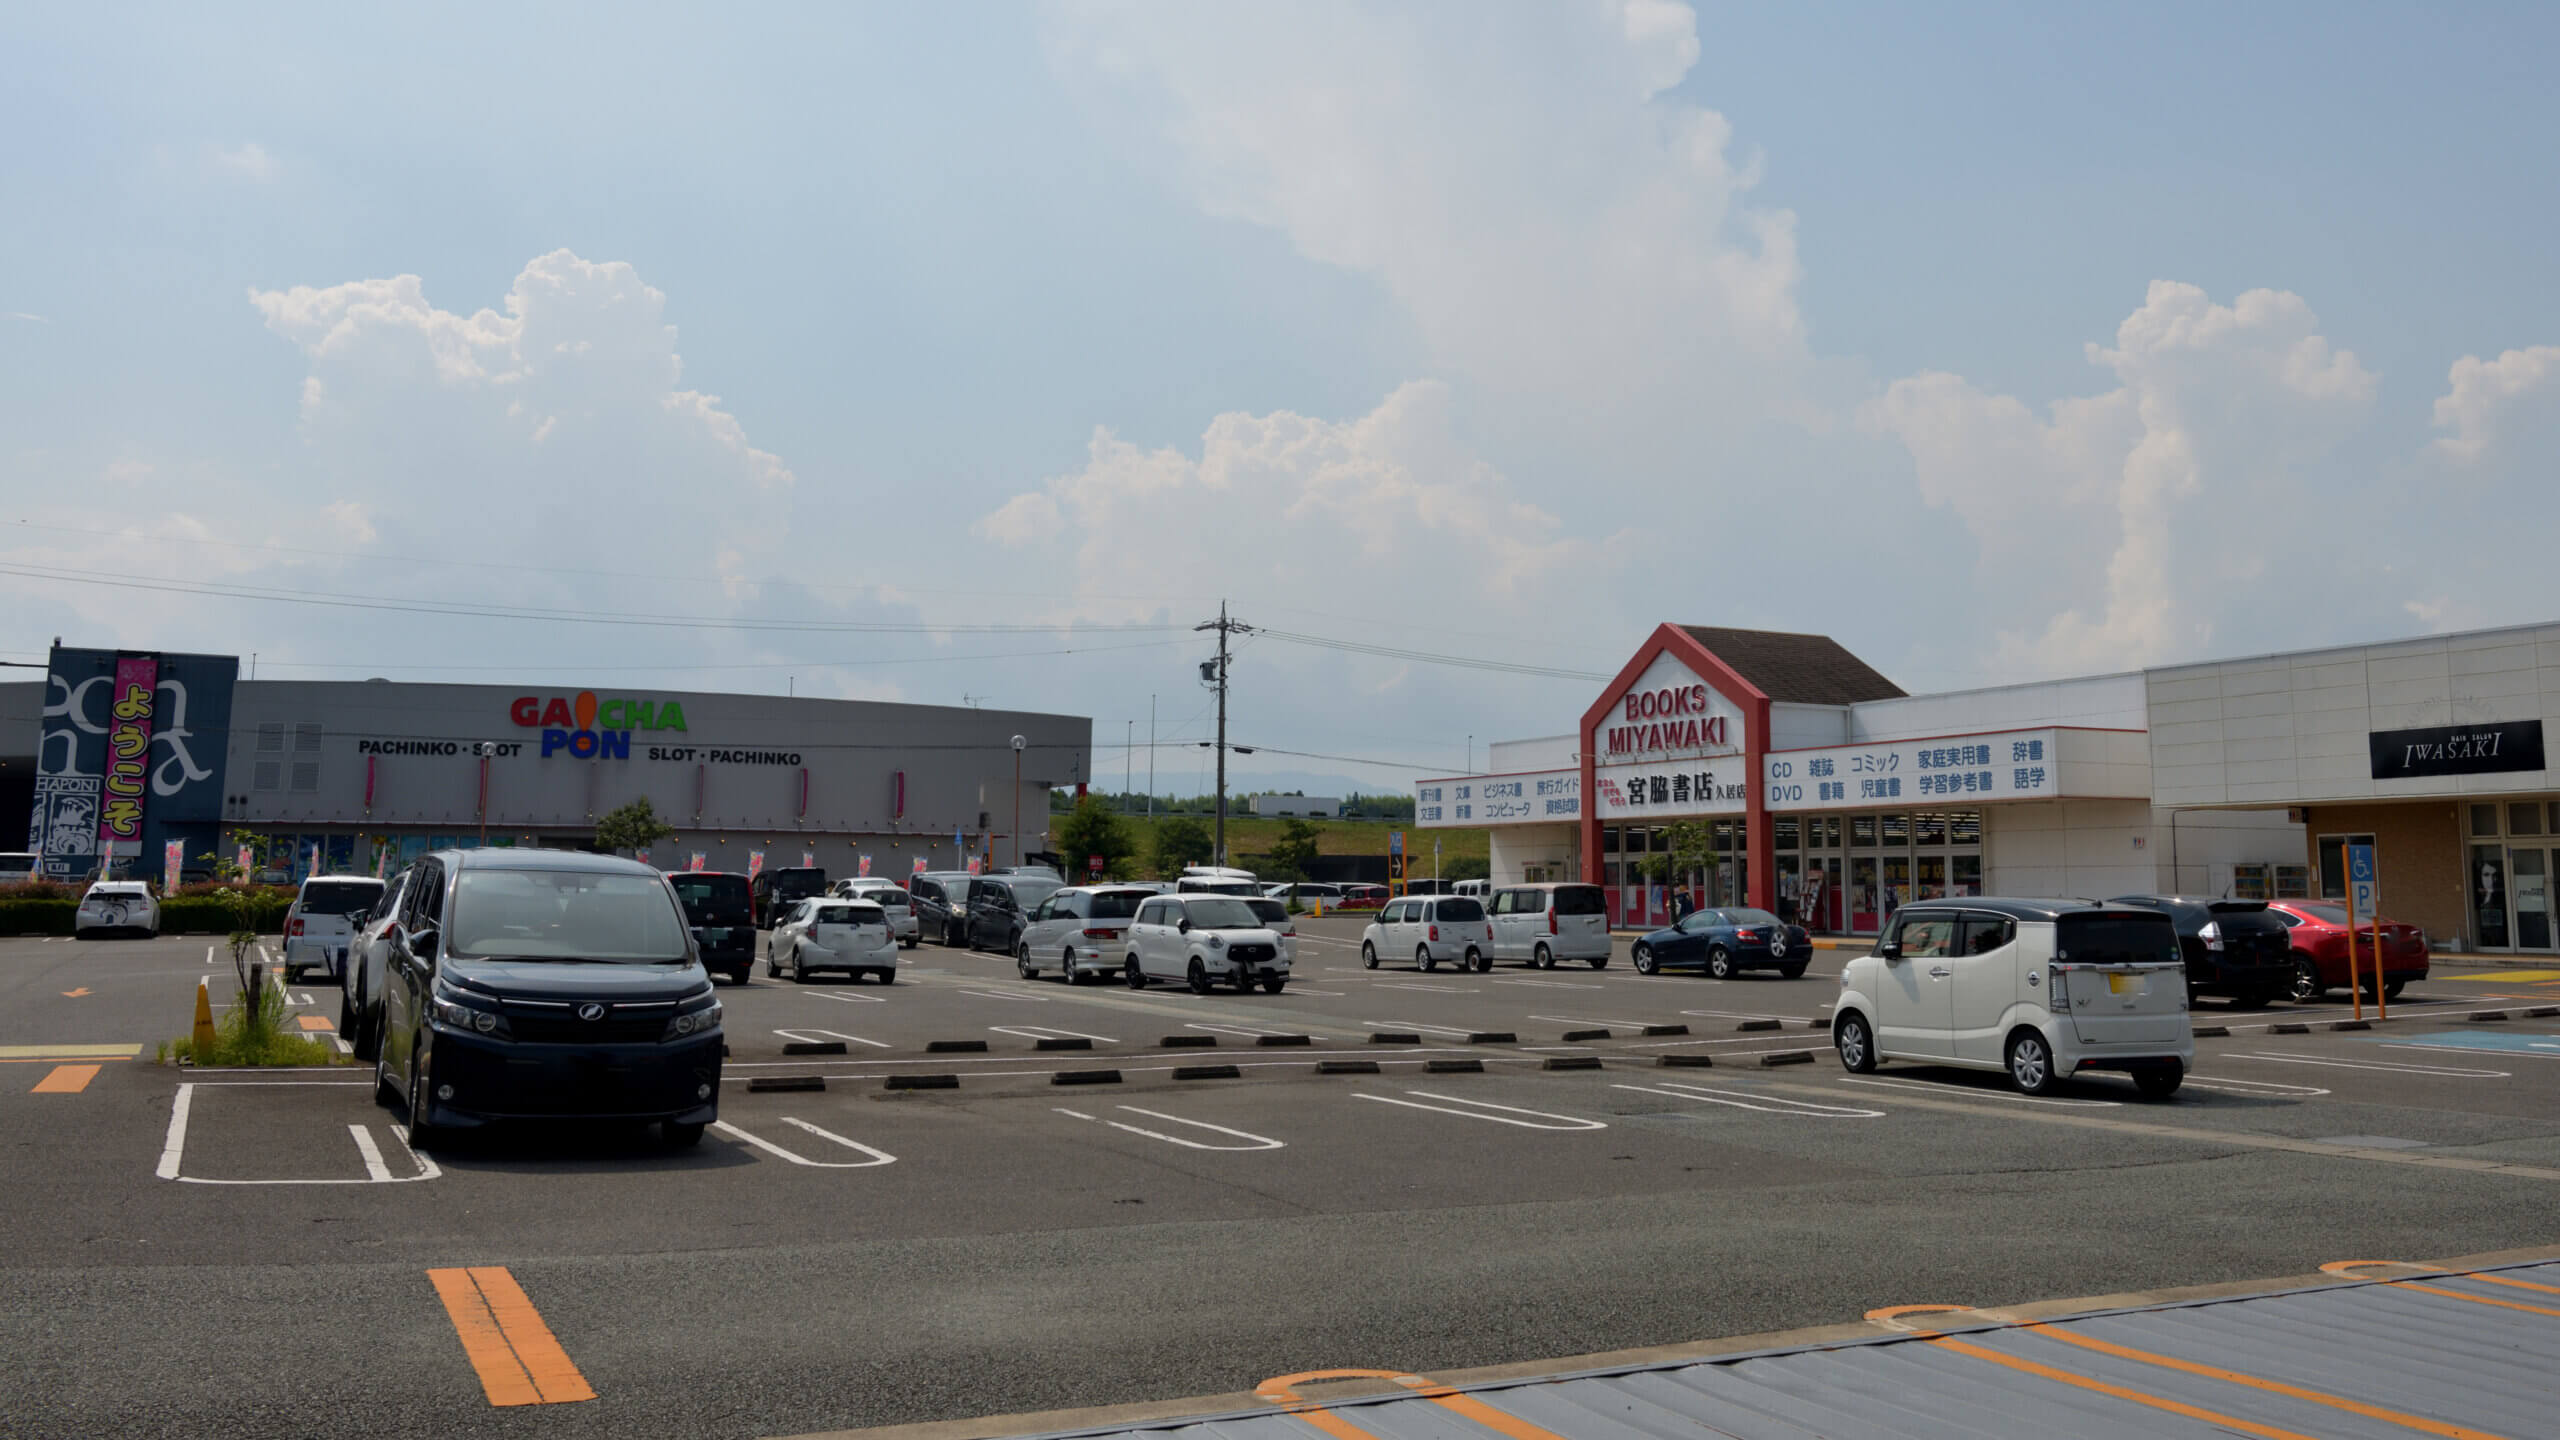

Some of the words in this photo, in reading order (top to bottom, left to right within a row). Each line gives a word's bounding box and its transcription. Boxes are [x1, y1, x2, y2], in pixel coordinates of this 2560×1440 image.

[1626, 684, 1706, 721] BOOKS
[359, 740, 458, 756] PACHINKO
[472, 743, 522, 757] SOT
[541, 729, 630, 759] PON
[1609, 716, 1725, 754] MIYAWAKI
[2402, 732, 2502, 768] IWASAKI
[103, 683, 152, 836] ようこそ
[649, 748, 697, 761] SLOT
[710, 750, 801, 766] PACHINKO
[1772, 762, 1792, 778] CD
[1809, 758, 1834, 777] 雑誌
[1851, 752, 1900, 772] コミック
[1918, 744, 1990, 769] 家庭実用書
[2013, 740, 2043, 761] 辞書
[1536, 778, 1579, 796] 旅行ガイド
[1627, 772, 1713, 805] 宮脇書店
[1716, 784, 1748, 800] 久居店
[1772, 785, 1802, 801] DVD
[1819, 781, 1845, 801] 書籍
[1861, 777, 1901, 799] 児童書
[1919, 771, 1993, 794] 学習参考書
[2014, 767, 2045, 789] 語学
[1485, 802, 1531, 818] コンピュータ
[2358, 885, 2369, 906] P
